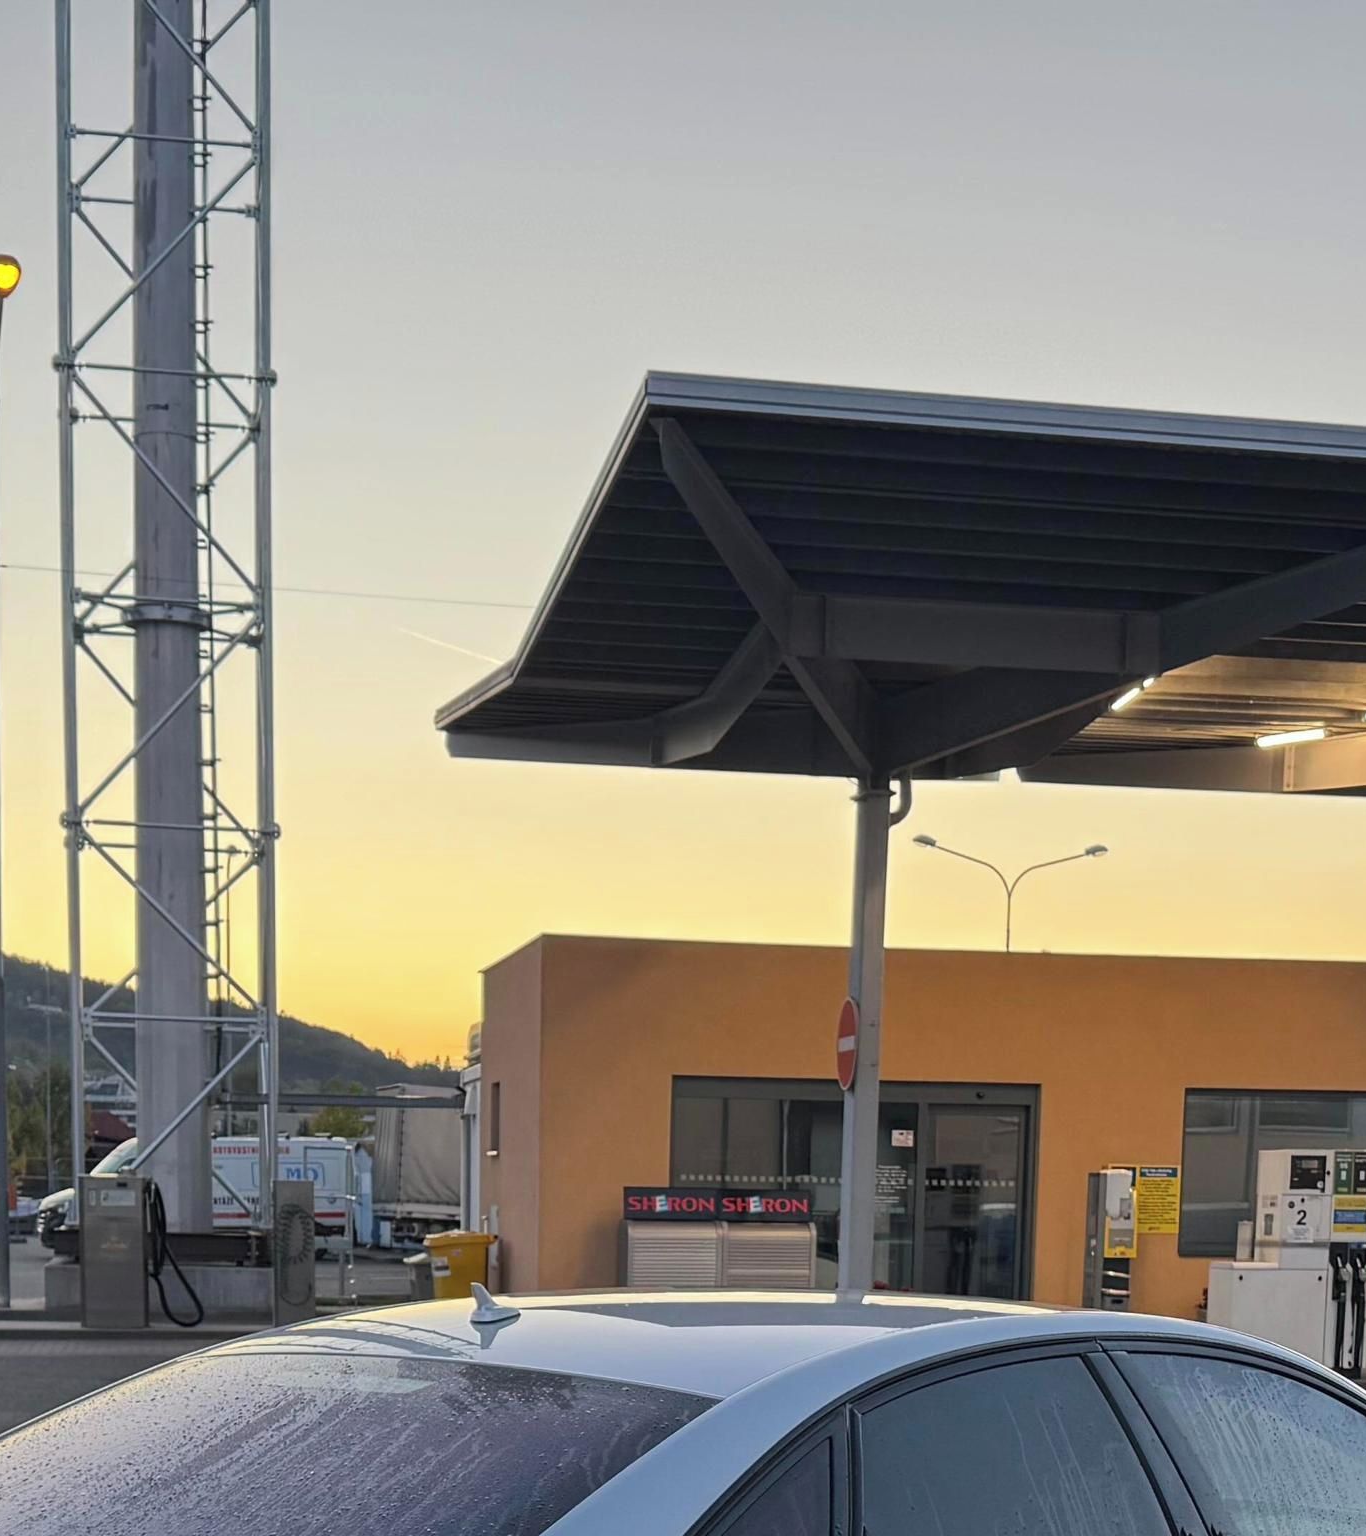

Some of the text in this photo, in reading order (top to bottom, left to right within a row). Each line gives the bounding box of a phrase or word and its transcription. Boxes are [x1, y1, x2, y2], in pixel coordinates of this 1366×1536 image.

[628, 1195, 715, 1213] SHERON
[721, 1196, 808, 1215] SHERON
[1296, 1209, 1307, 1226] 2
